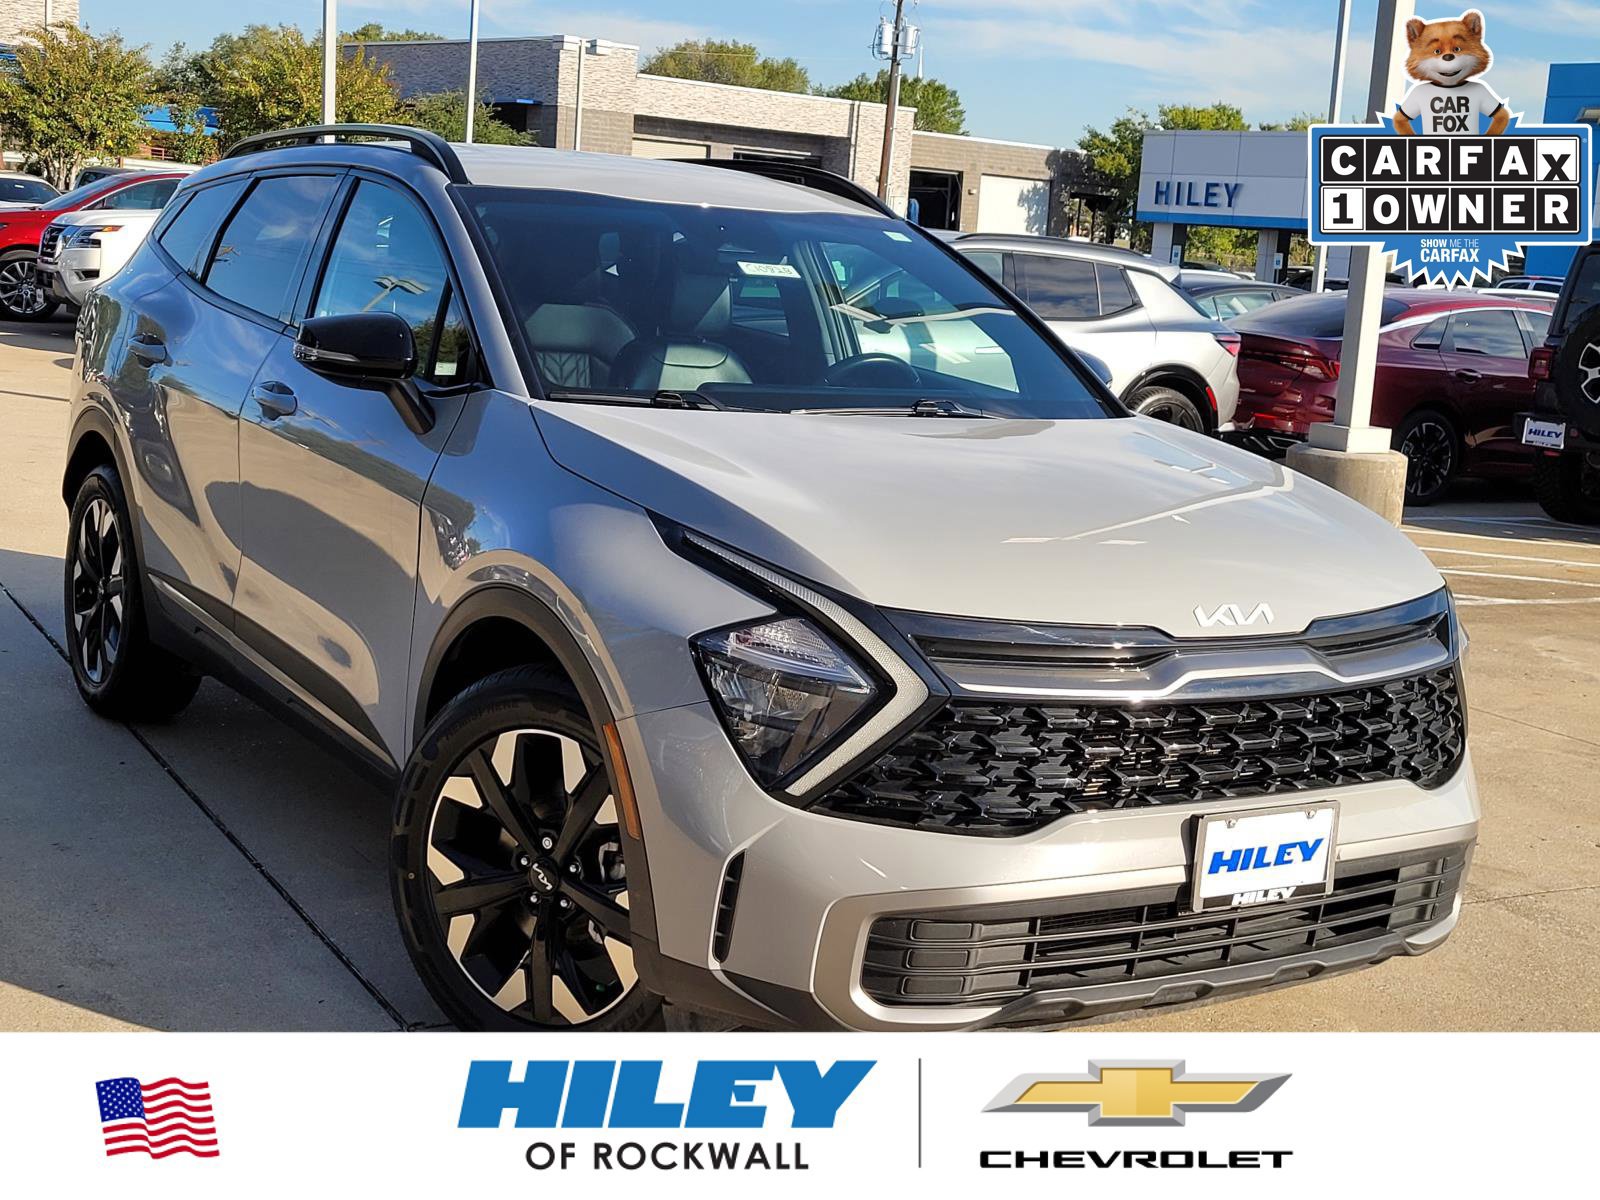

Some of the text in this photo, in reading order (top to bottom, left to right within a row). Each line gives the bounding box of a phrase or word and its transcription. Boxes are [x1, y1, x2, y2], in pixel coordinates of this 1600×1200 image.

[1154, 181, 1242, 208] HILEY
[1528, 428, 1562, 438] HILEY
[1208, 838, 1325, 875] HILEY
[1231, 886, 1297, 906] HILEY
